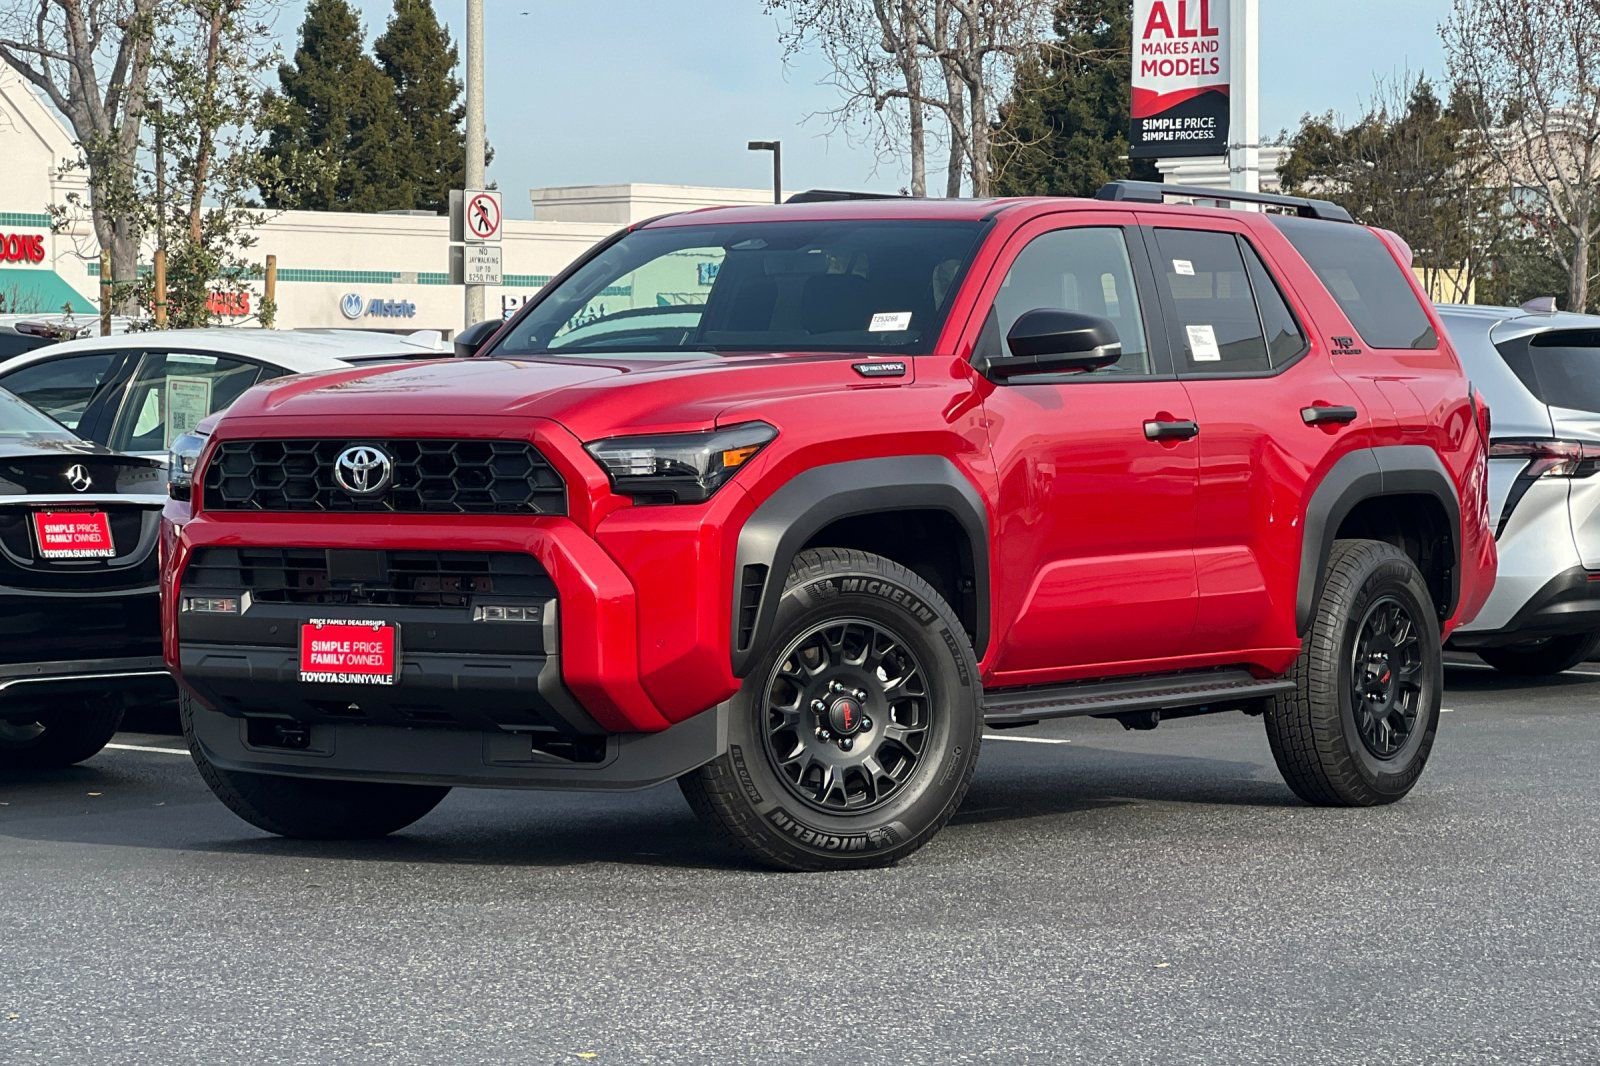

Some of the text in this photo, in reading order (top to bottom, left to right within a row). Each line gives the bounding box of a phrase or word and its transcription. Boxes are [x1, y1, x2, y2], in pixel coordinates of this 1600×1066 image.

[1142, 0, 1219, 39] ALL
[1141, 40, 1219, 55] MAKES AND
[1141, 57, 1220, 77] MODELS
[1142, 117, 1217, 130] SIMPLE PRICE.
[1142, 130, 1216, 141] SIMPLE PROCESS.
[479, 248, 488, 256] NO
[468, 257, 499, 265] JAYWALKING
[485, 274, 498, 282] FINE
[364, 299, 416, 318] Allstate
[44, 524, 102, 533] SIMPLE PRICE.
[46, 533, 103, 543] FAMILY OWNED.
[841, 579, 933, 621] MICHELIN
[311, 641, 384, 653] SIMPLE PRICE.
[311, 654, 384, 666] FAMILY OWNED.
[944, 633, 967, 681] LTX TRAIL
[771, 811, 866, 851] MICHELIN
